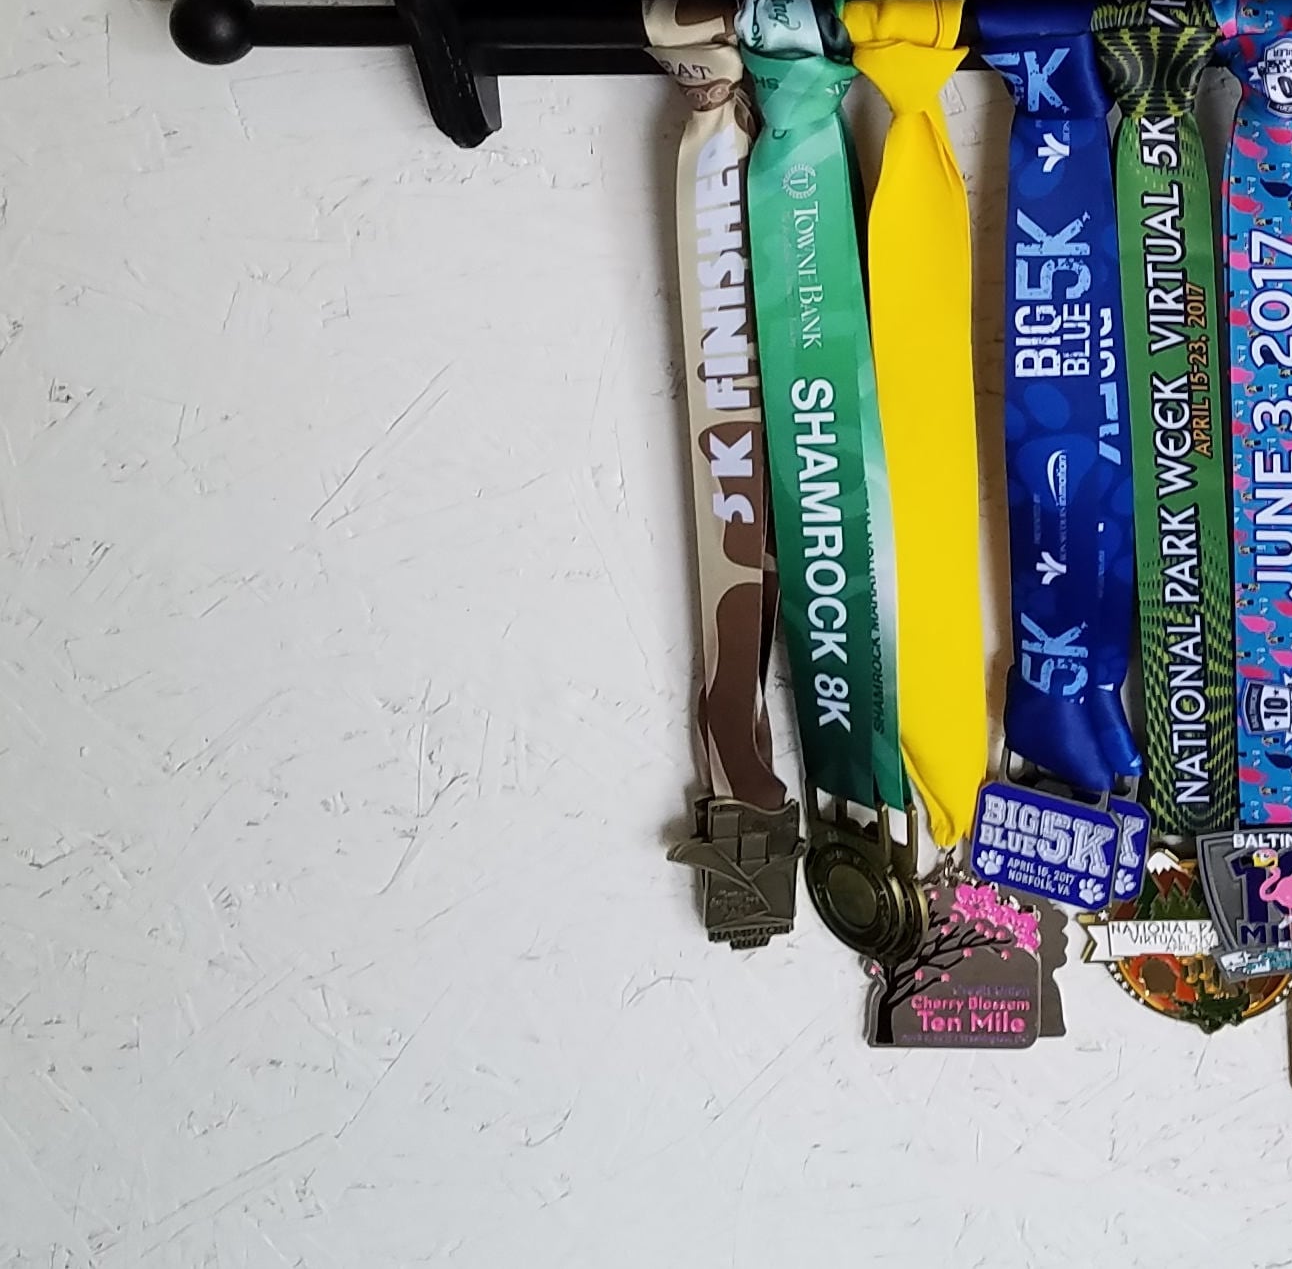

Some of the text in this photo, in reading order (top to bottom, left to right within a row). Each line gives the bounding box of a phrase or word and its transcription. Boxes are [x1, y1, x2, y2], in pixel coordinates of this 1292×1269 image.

[1016, 208, 1092, 302] 5K
[1186, 282, 1206, 327] 2017
[1014, 304, 1061, 378] BIG
[1062, 303, 1091, 378] BLUE
[1191, 397, 1213, 459] APRIL
[1141, 115, 1210, 805] NATIONAL PARK WEEK VIRTUAL 5K
[791, 378, 851, 733] SHAMROCK 8K
[1021, 612, 1089, 700] 5K
[1263, 697, 1288, 719] 10
[979, 823, 1038, 858] BLUE
[982, 793, 1041, 835] BIG
[1036, 809, 1116, 879] 5K
[1007, 857, 1035, 873] APRIL
[1054, 869, 1075, 885] 2017
[1008, 870, 1071, 897] NORFOLK, VA
[1111, 921, 1188, 934] NATIONAL
[911, 994, 1030, 1013] Cherry Blossom
[917, 1010, 1026, 1033] Ten Mile
